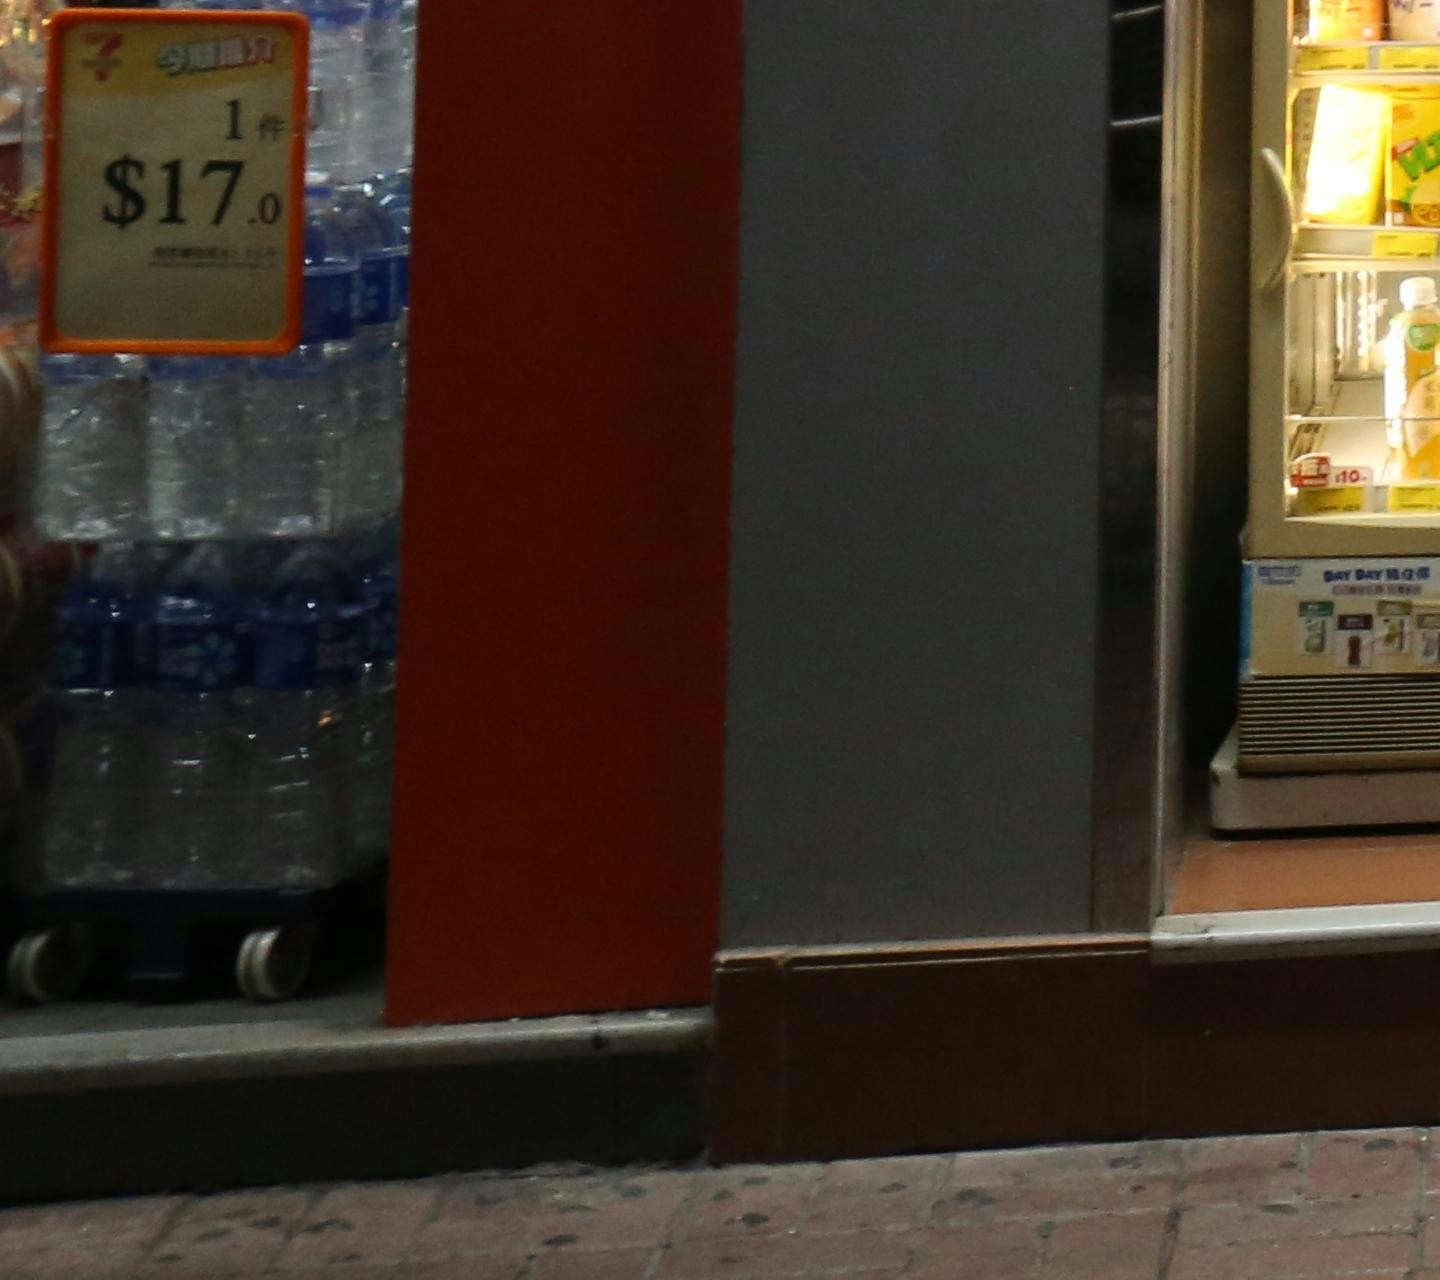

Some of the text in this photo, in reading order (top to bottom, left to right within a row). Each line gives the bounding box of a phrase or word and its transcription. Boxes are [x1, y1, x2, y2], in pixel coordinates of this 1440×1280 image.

[225, 98, 285, 140] 1 件
[101, 153, 281, 230] $17.0
[1323, 570, 1350, 582] DAY
[1356, 568, 1383, 581] DAY
